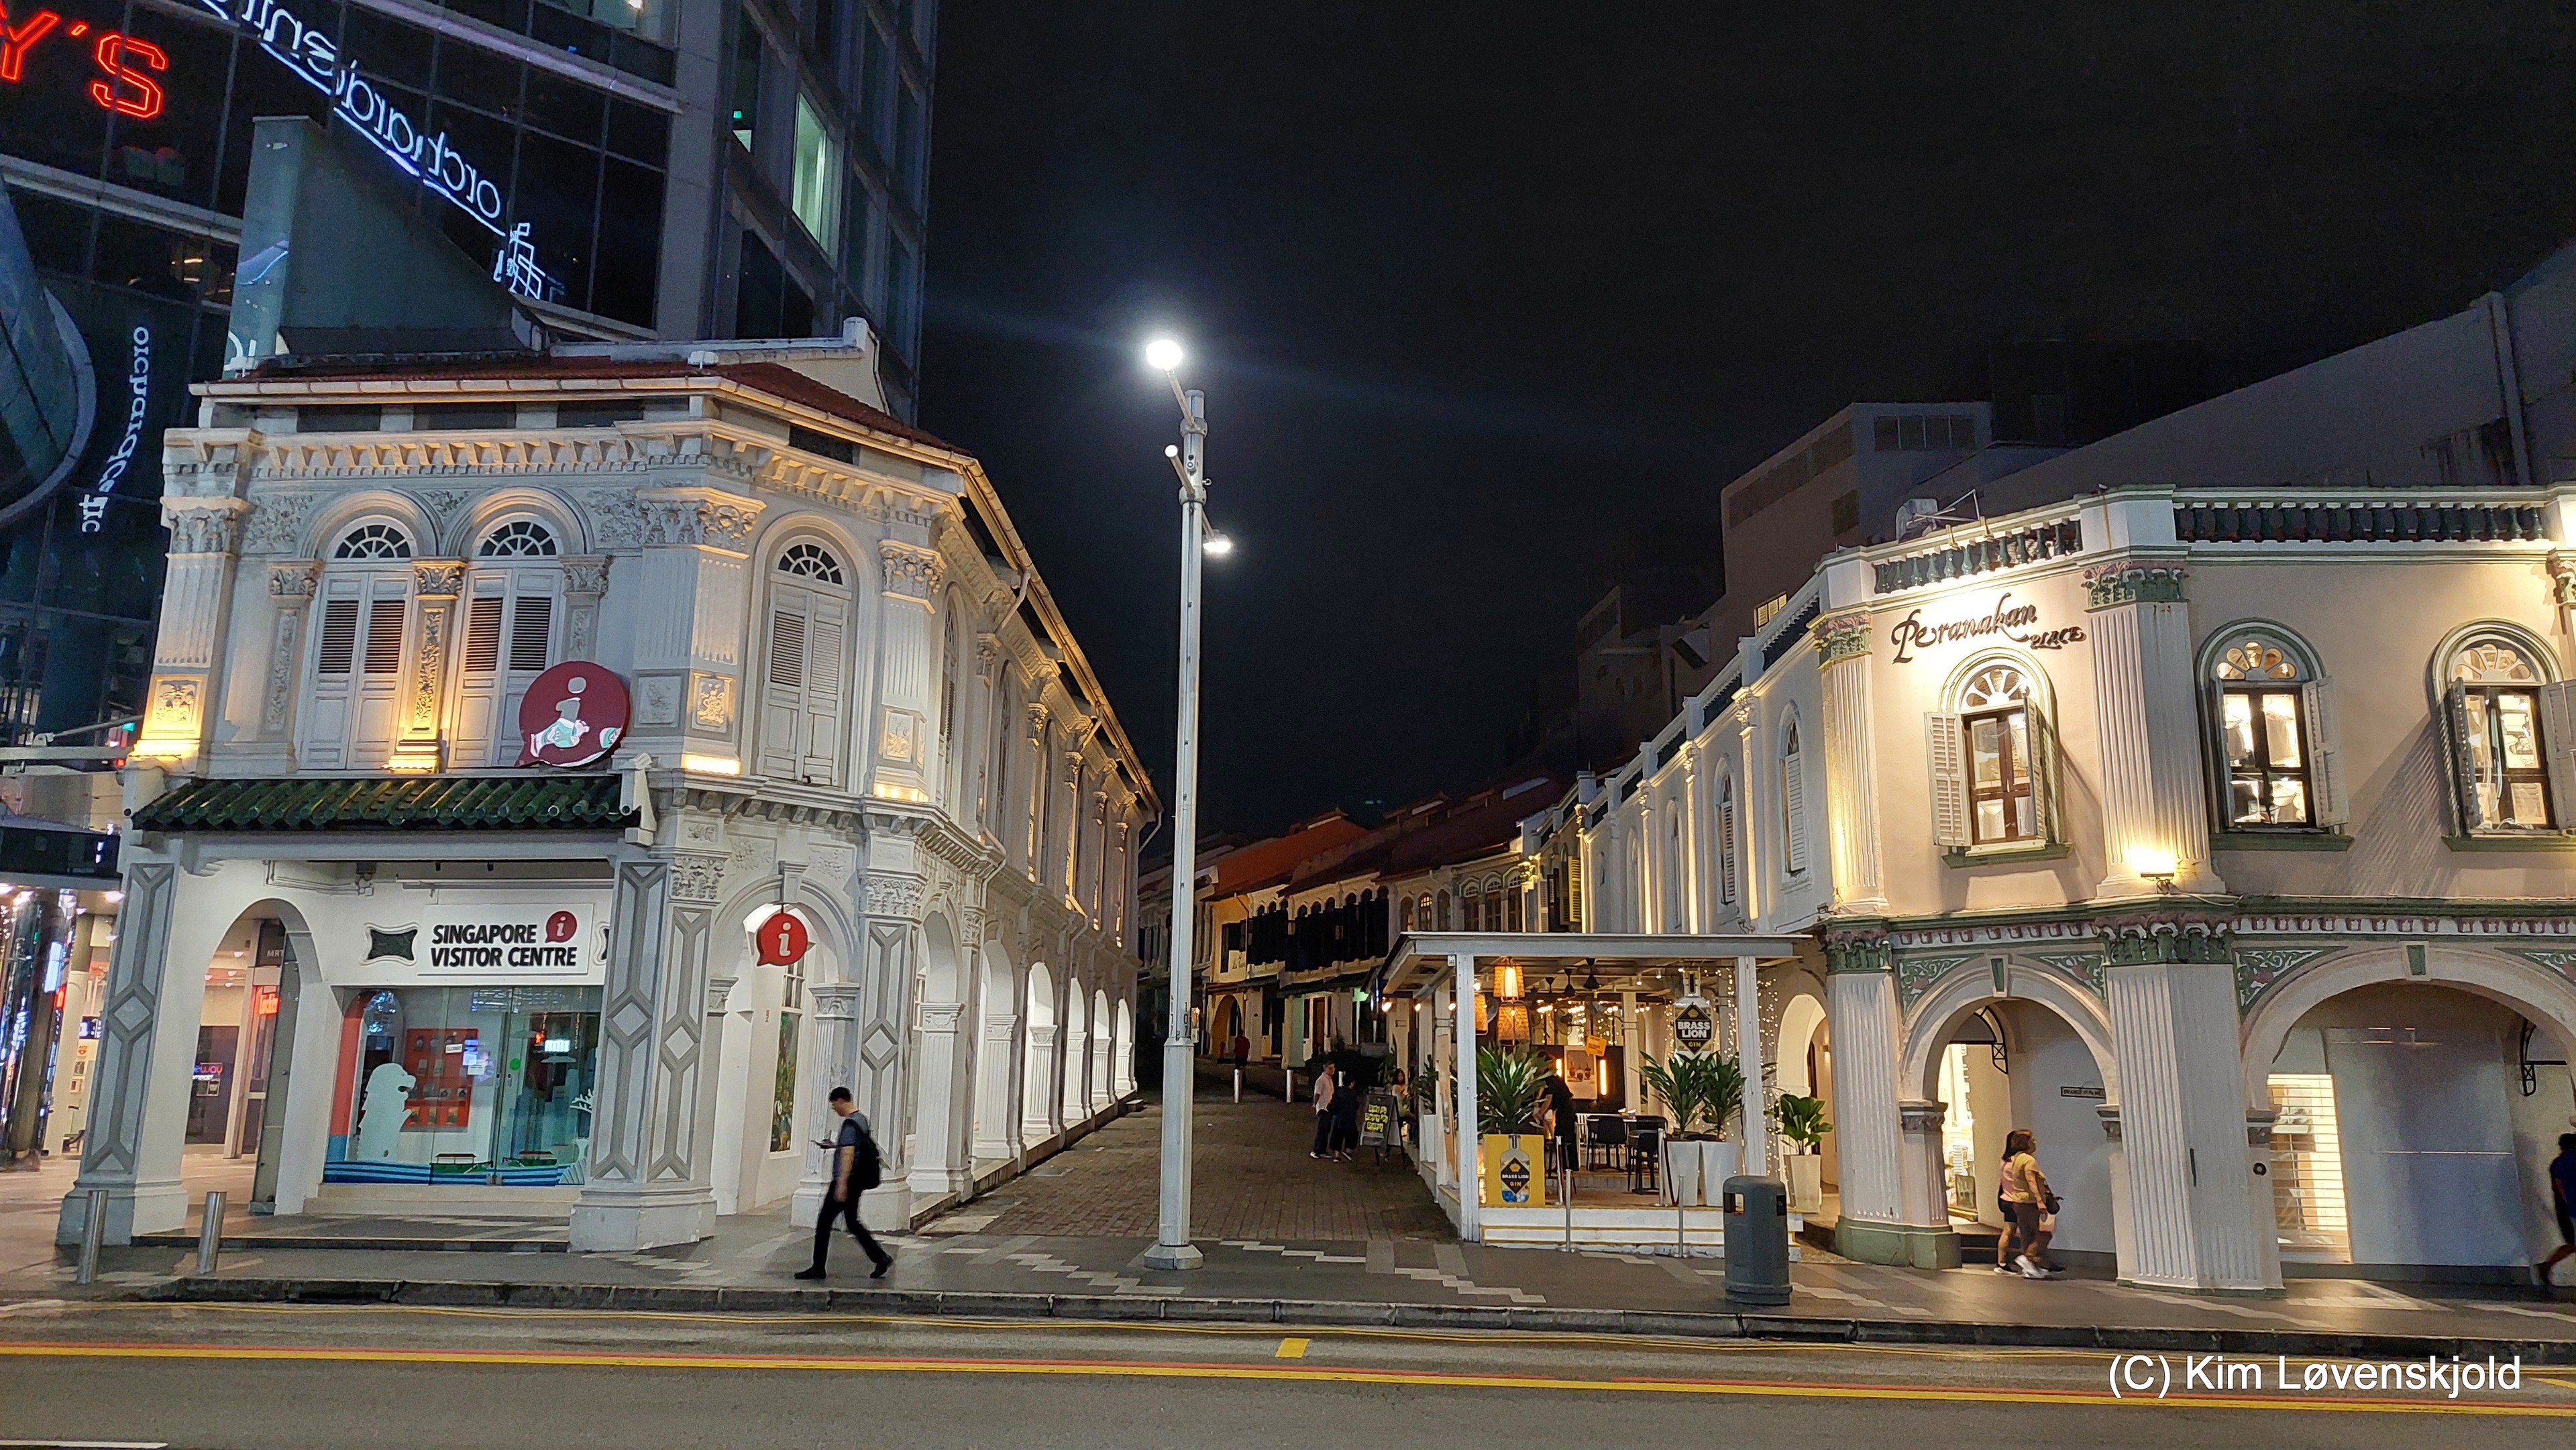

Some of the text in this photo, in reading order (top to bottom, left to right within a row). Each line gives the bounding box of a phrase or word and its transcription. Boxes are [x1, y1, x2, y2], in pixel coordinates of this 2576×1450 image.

[1891, 592, 2088, 665] Peranakan PLACE
[431, 924, 537, 944] SINGAPORE
[430, 946, 578, 967] VISITOR CENTRE
[1678, 1021, 1711, 1029] BRASS
